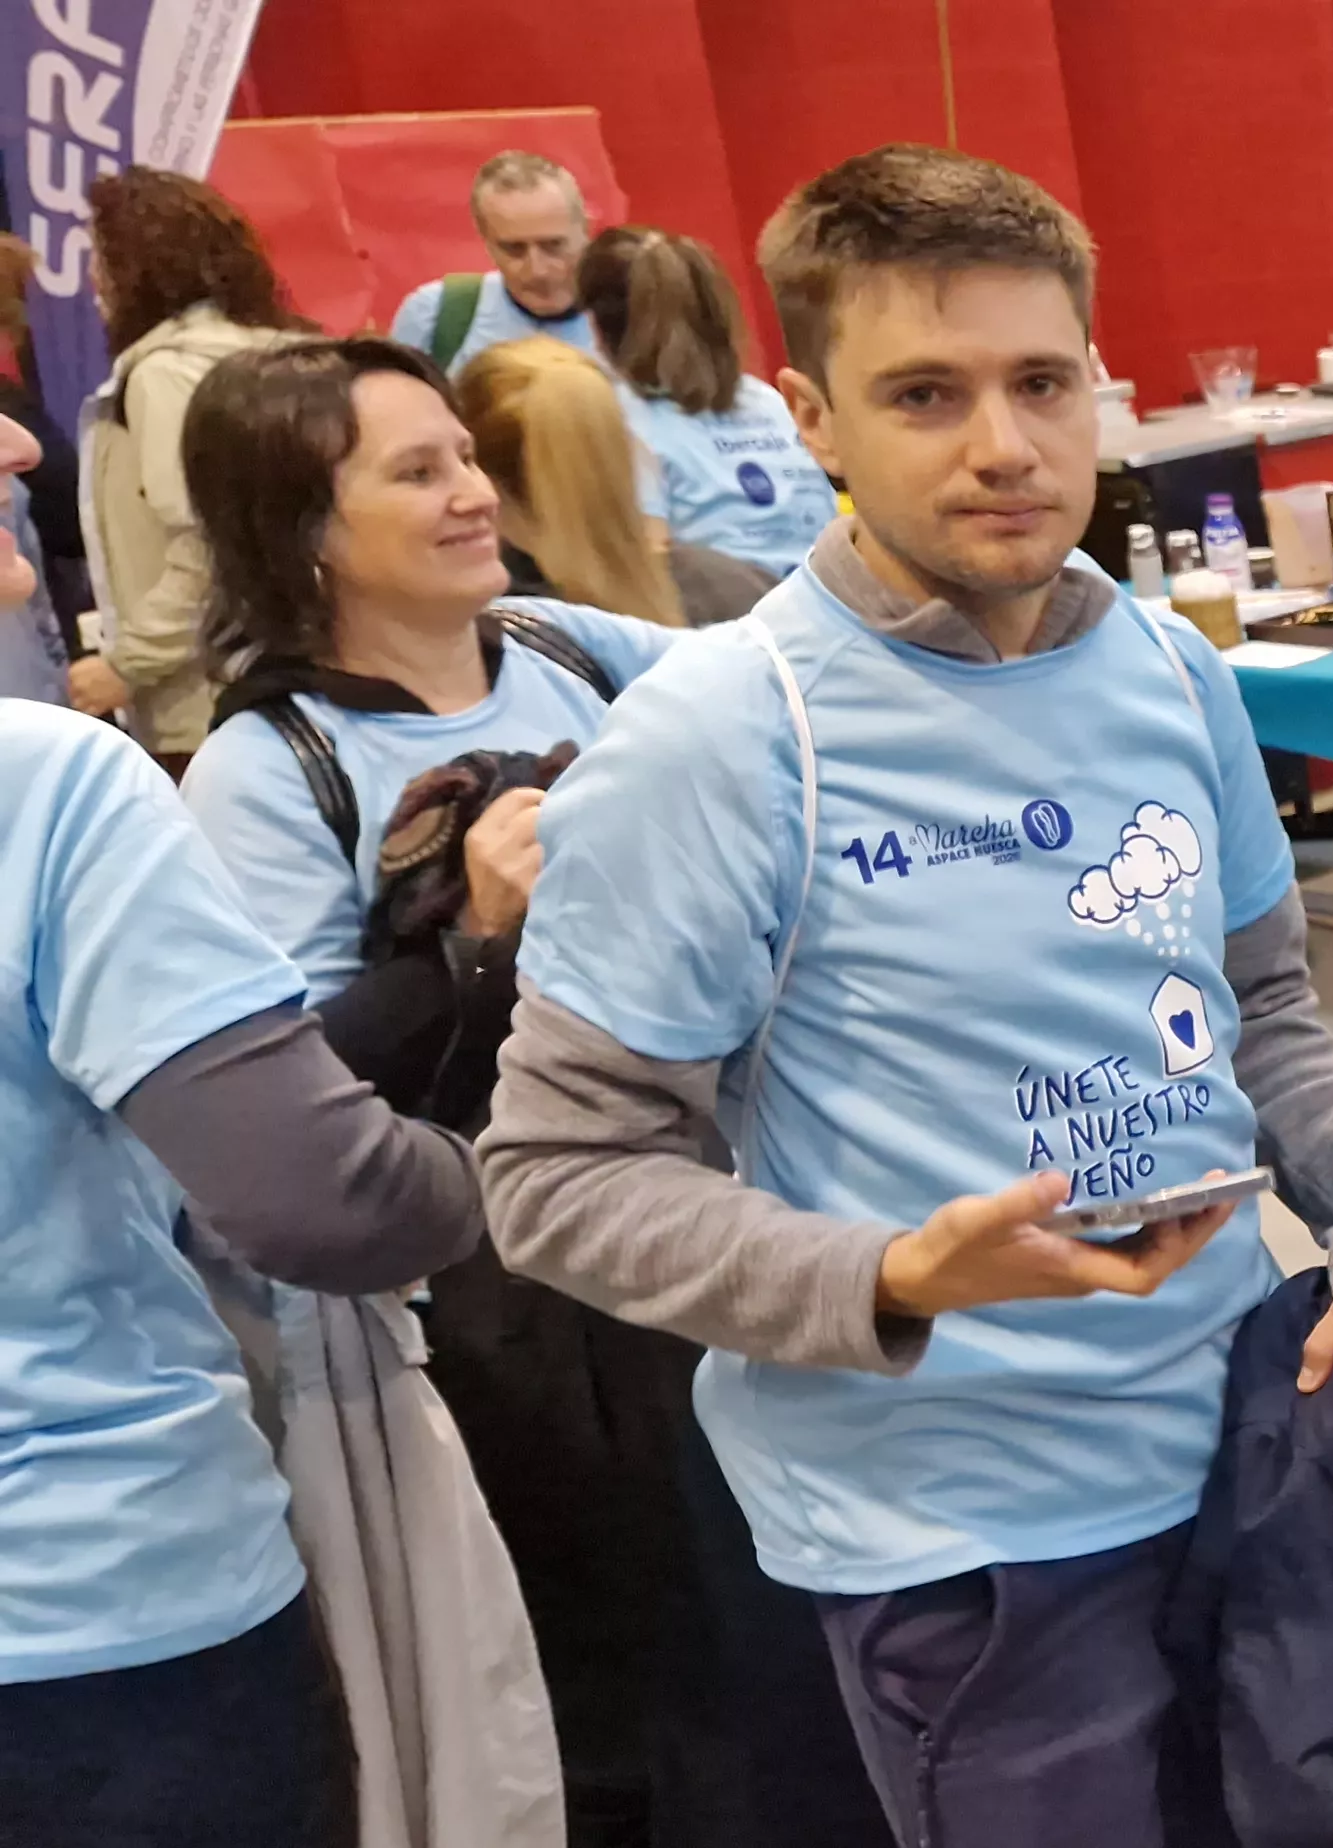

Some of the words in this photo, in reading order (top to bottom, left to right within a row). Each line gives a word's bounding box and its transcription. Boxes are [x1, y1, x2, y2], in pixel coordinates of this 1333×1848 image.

[914, 813, 1018, 852] Marcha
[926, 849, 971, 867] ASPACE
[973, 838, 1021, 856] HUESCA
[1014, 1056, 1139, 1121] ÚNETE
[1027, 1129, 1054, 1169] A
[1066, 1084, 1210, 1160] NUESTRO
[1066, 1143, 1156, 1206] EÑO
